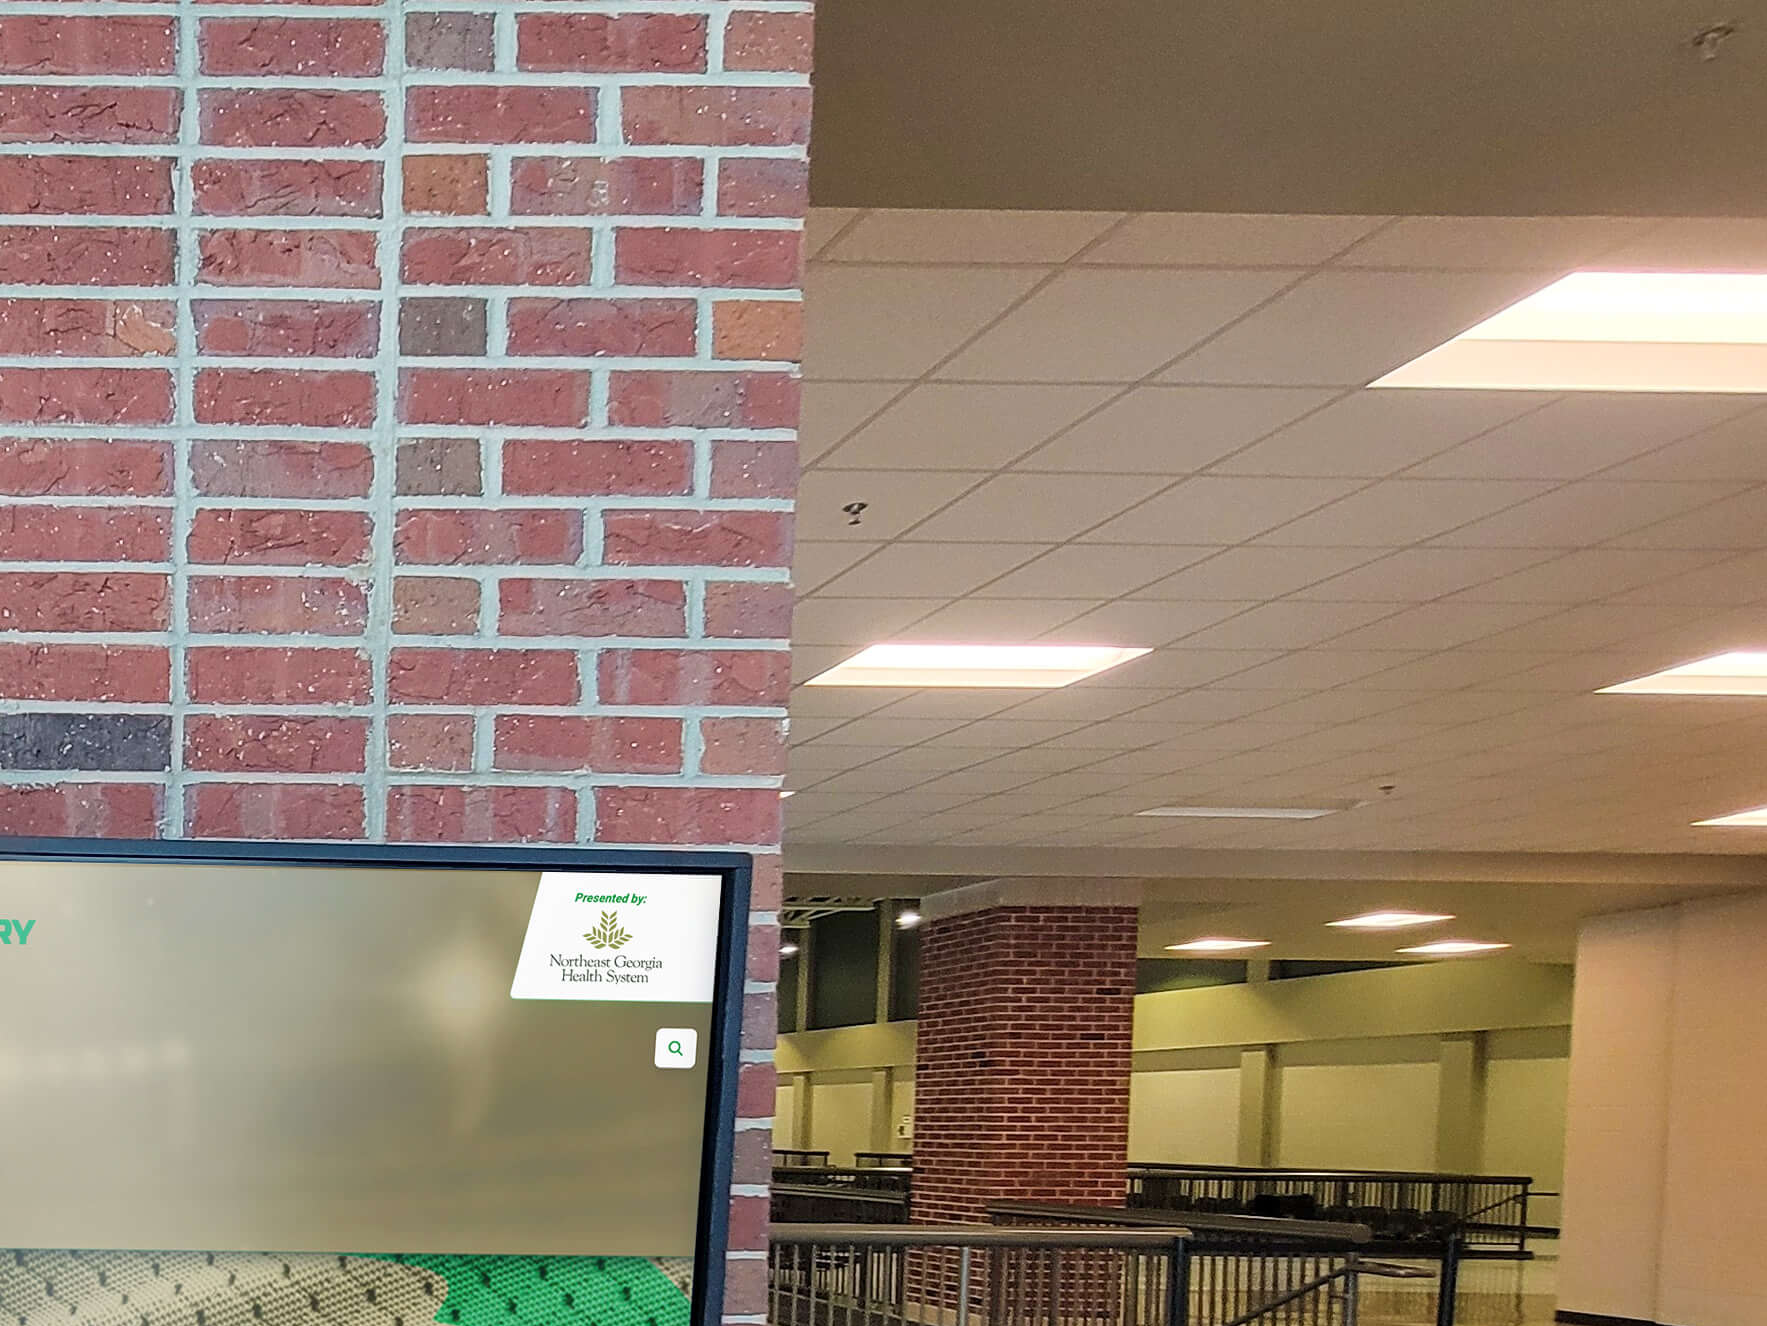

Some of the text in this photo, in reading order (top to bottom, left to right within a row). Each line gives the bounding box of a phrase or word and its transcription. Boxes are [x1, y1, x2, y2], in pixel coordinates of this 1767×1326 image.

[574, 892, 647, 906] Presented by:
[549, 954, 663, 971] Northeast Georgia
[561, 969, 649, 984] Health System
